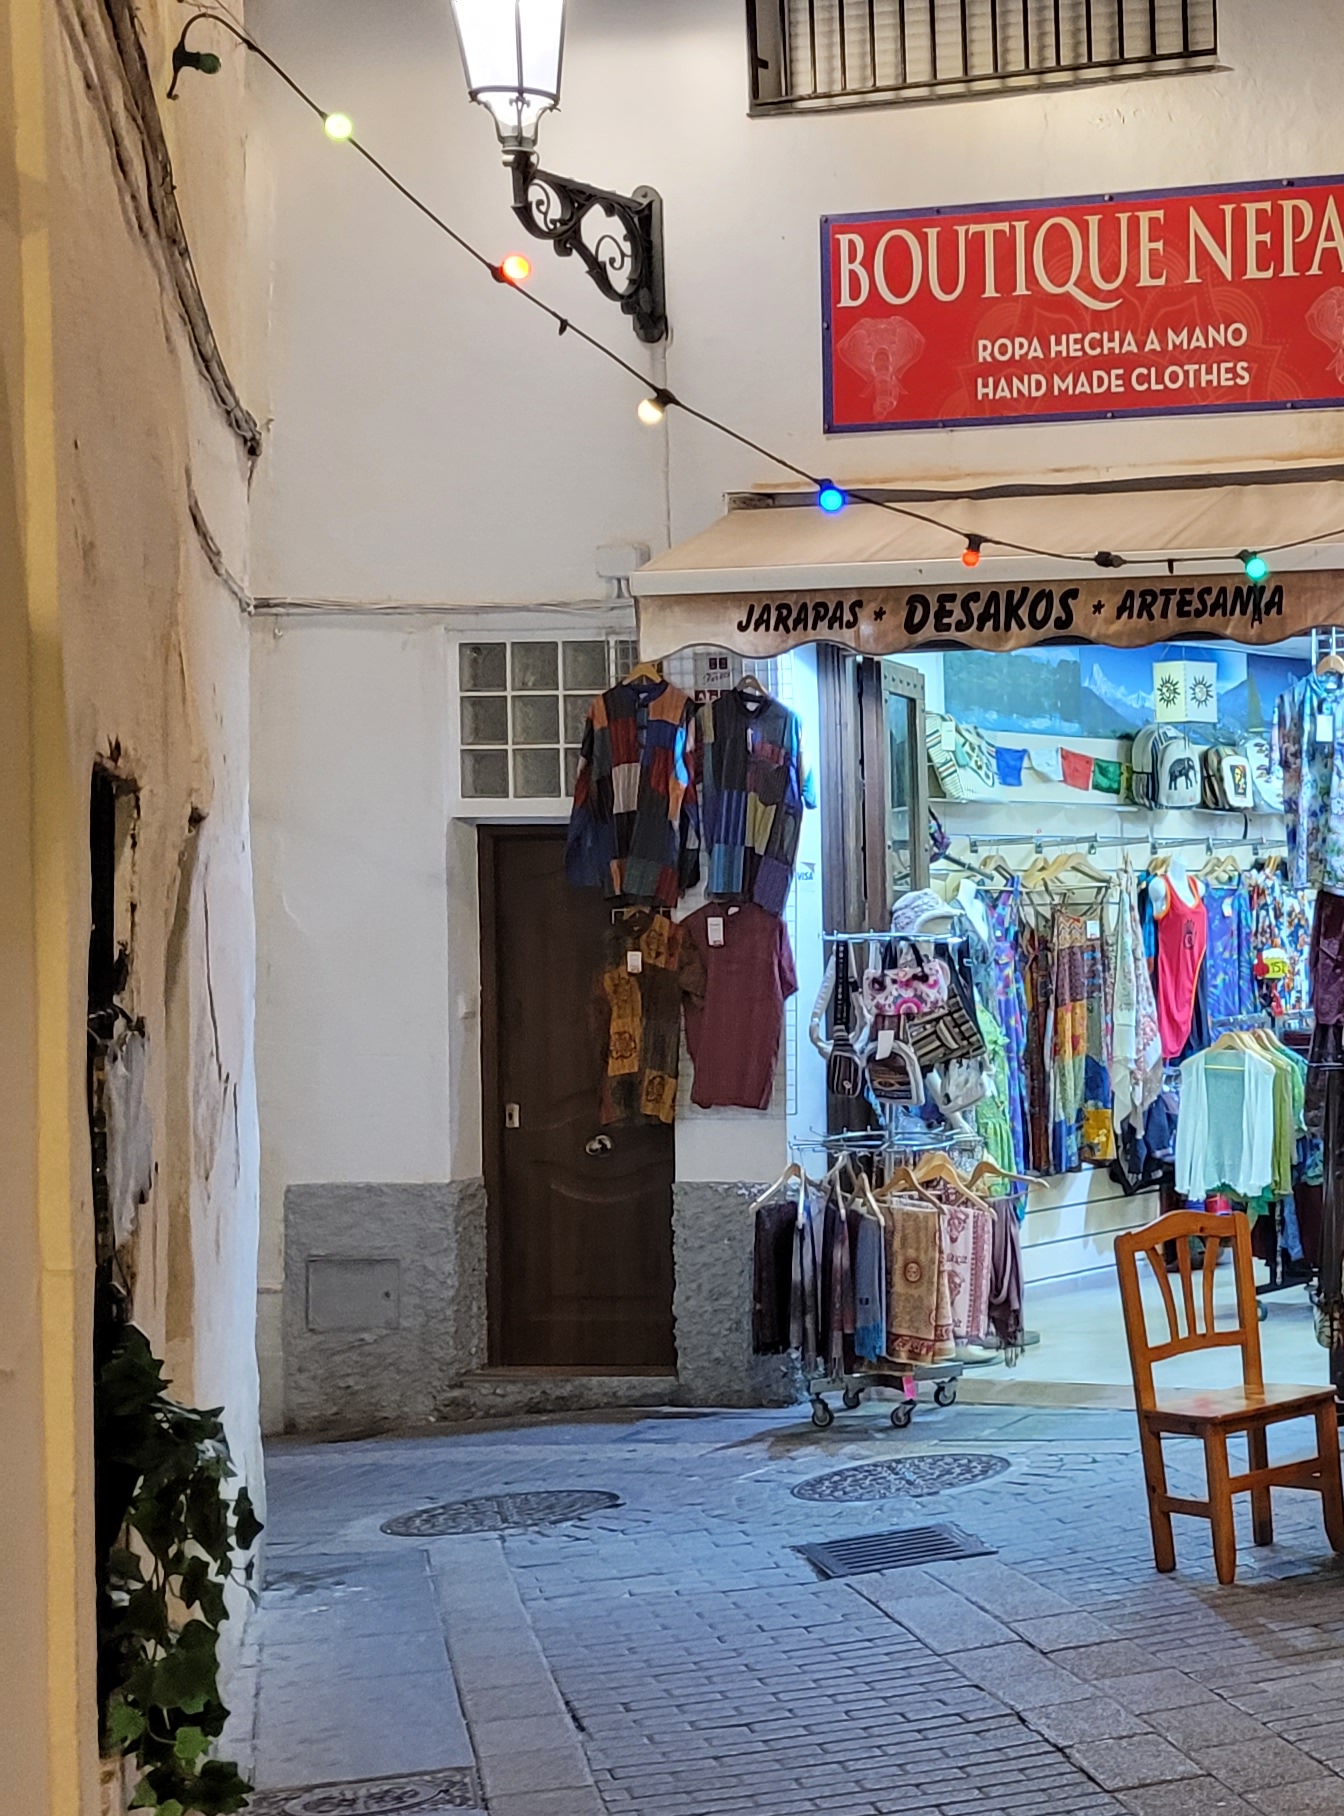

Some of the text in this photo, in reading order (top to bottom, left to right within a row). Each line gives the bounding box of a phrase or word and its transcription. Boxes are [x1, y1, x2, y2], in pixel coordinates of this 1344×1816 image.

[835, 209, 1167, 311] BOUTIQUE
[977, 322, 1249, 363] ROPA HECHA A MANO
[976, 361, 1251, 400] HAND MADE CLOTHES
[736, 599, 864, 634] JARAPAS
[903, 586, 1077, 634] DESAKOS
